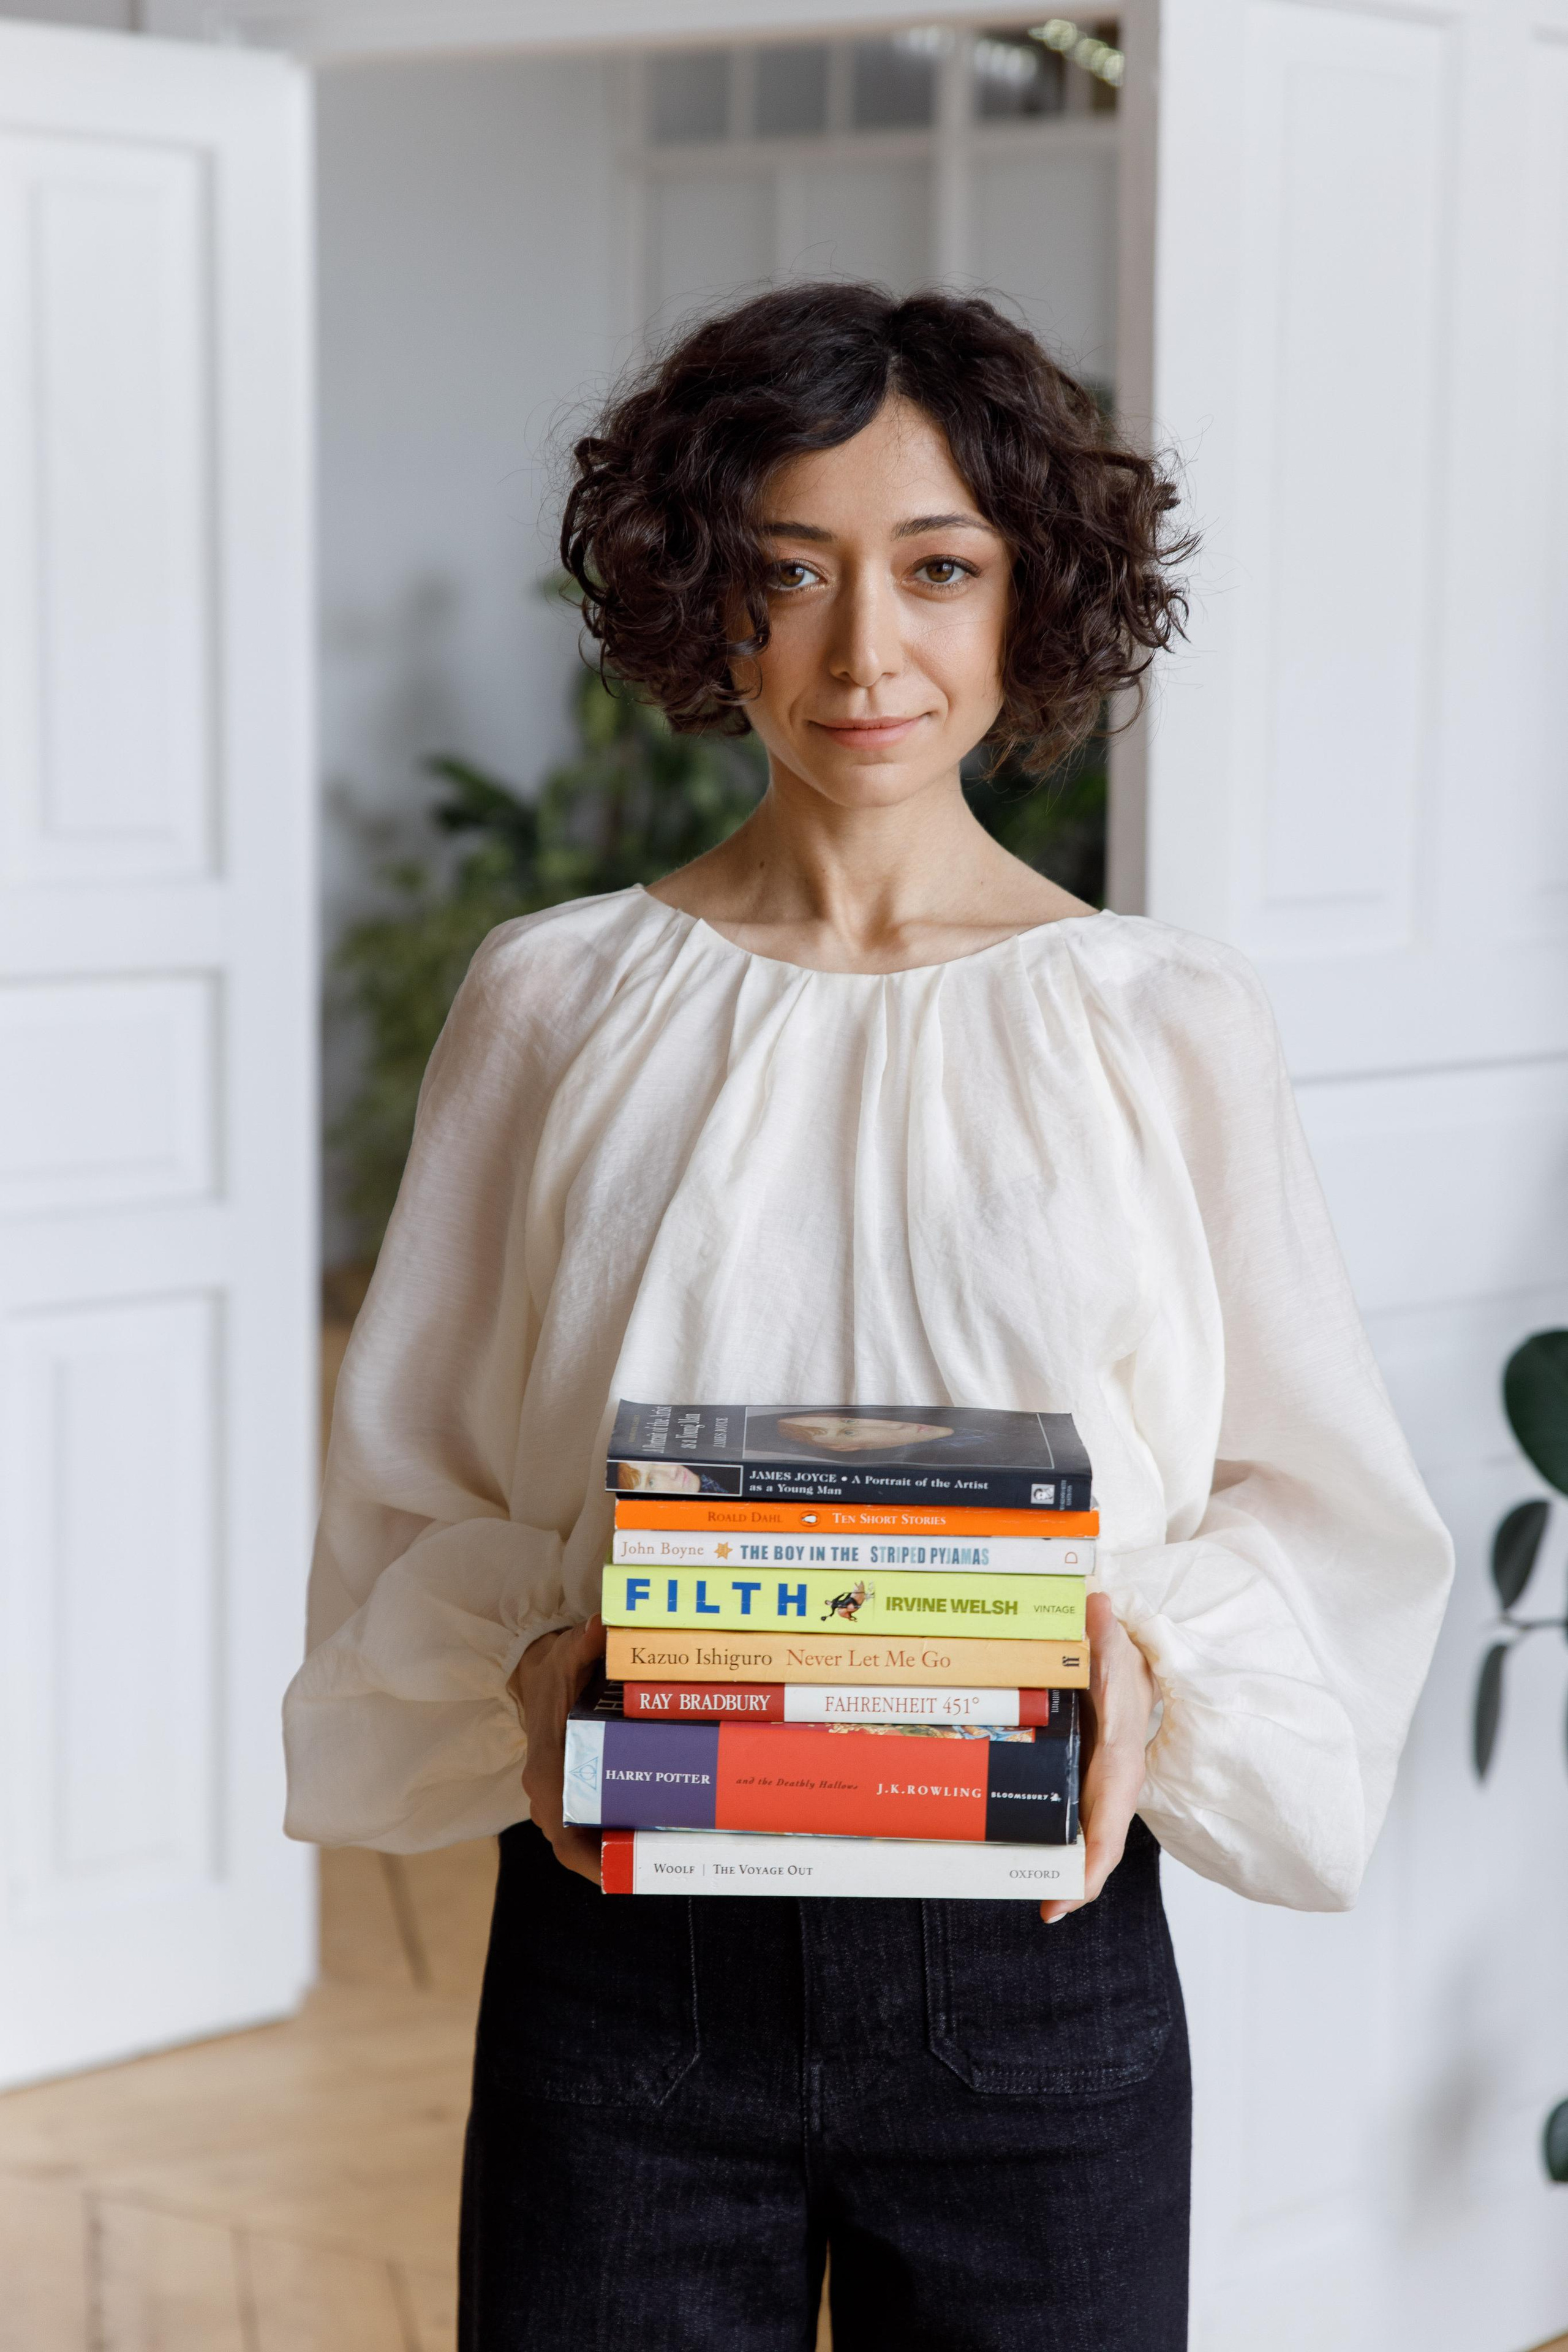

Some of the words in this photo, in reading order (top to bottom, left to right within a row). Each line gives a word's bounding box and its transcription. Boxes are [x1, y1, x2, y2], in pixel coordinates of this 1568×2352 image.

[649, 1406, 672, 1418] Artist
[677, 1414, 700, 1424] Man
[675, 1425, 705, 1438] Young
[715, 1417, 728, 1432] JOYCE
[641, 1433, 667, 1449] Portrait
[713, 1433, 727, 1448] JAMES
[749, 1471, 791, 1481] JAMES
[794, 1472, 837, 1483] JOYCE
[851, 1475, 861, 1484] A
[865, 1476, 911, 1487] Portrait
[915, 1477, 928, 1487] of
[931, 1478, 951, 1488] the
[954, 1479, 989, 1490] Artist
[777, 1483, 814, 1495] Young
[816, 1485, 842, 1495] Man
[707, 1512, 747, 1523] ROALD
[751, 1512, 783, 1523] DAHL
[832, 1513, 856, 1524] TEN
[860, 1513, 898, 1525] SHORT
[901, 1514, 947, 1525] STORIES
[621, 1541, 654, 1556] John
[661, 1542, 704, 1559] Boyne
[741, 1545, 768, 1559] THE
[774, 1546, 805, 1561] BOY
[810, 1547, 826, 1561] IN
[831, 1547, 859, 1562] THE
[870, 1546, 925, 1564] STRIPED
[930, 1548, 989, 1566] PYJAMAS
[626, 1578, 807, 1616] FILTH
[886, 1596, 947, 1613] IRVINE
[951, 1599, 1018, 1615] WELSH
[1033, 1605, 1076, 1615] VINTAGE
[630, 1647, 689, 1665] Kazuo
[695, 1648, 772, 1671] Ishiguro
[786, 1649, 842, 1667] Never
[848, 1649, 880, 1667] Let
[884, 1650, 915, 1667] Me
[922, 1651, 951, 1668] Go
[639, 1693, 673, 1709] RAY
[679, 1694, 771, 1711] BRADBURY
[825, 1696, 937, 1713] FAHRENHEIT
[942, 1696, 980, 1716] 451°
[605, 1770, 653, 1781] HARRY
[655, 1772, 710, 1784] POTTER
[758, 1777, 772, 1786] the
[776, 1778, 815, 1790] Deathly
[819, 1781, 859, 1790] Hallows
[876, 1783, 982, 1798] J.K.ROWLING
[991, 1791, 1049, 1801] BLOOMSBURY
[654, 1863, 695, 1874] WOOLF
[713, 1864, 736, 1874] THE
[739, 1864, 785, 1875] VOYAGE
[788, 1865, 813, 1876] OUT
[1009, 1869, 1060, 1879] OXFORD
